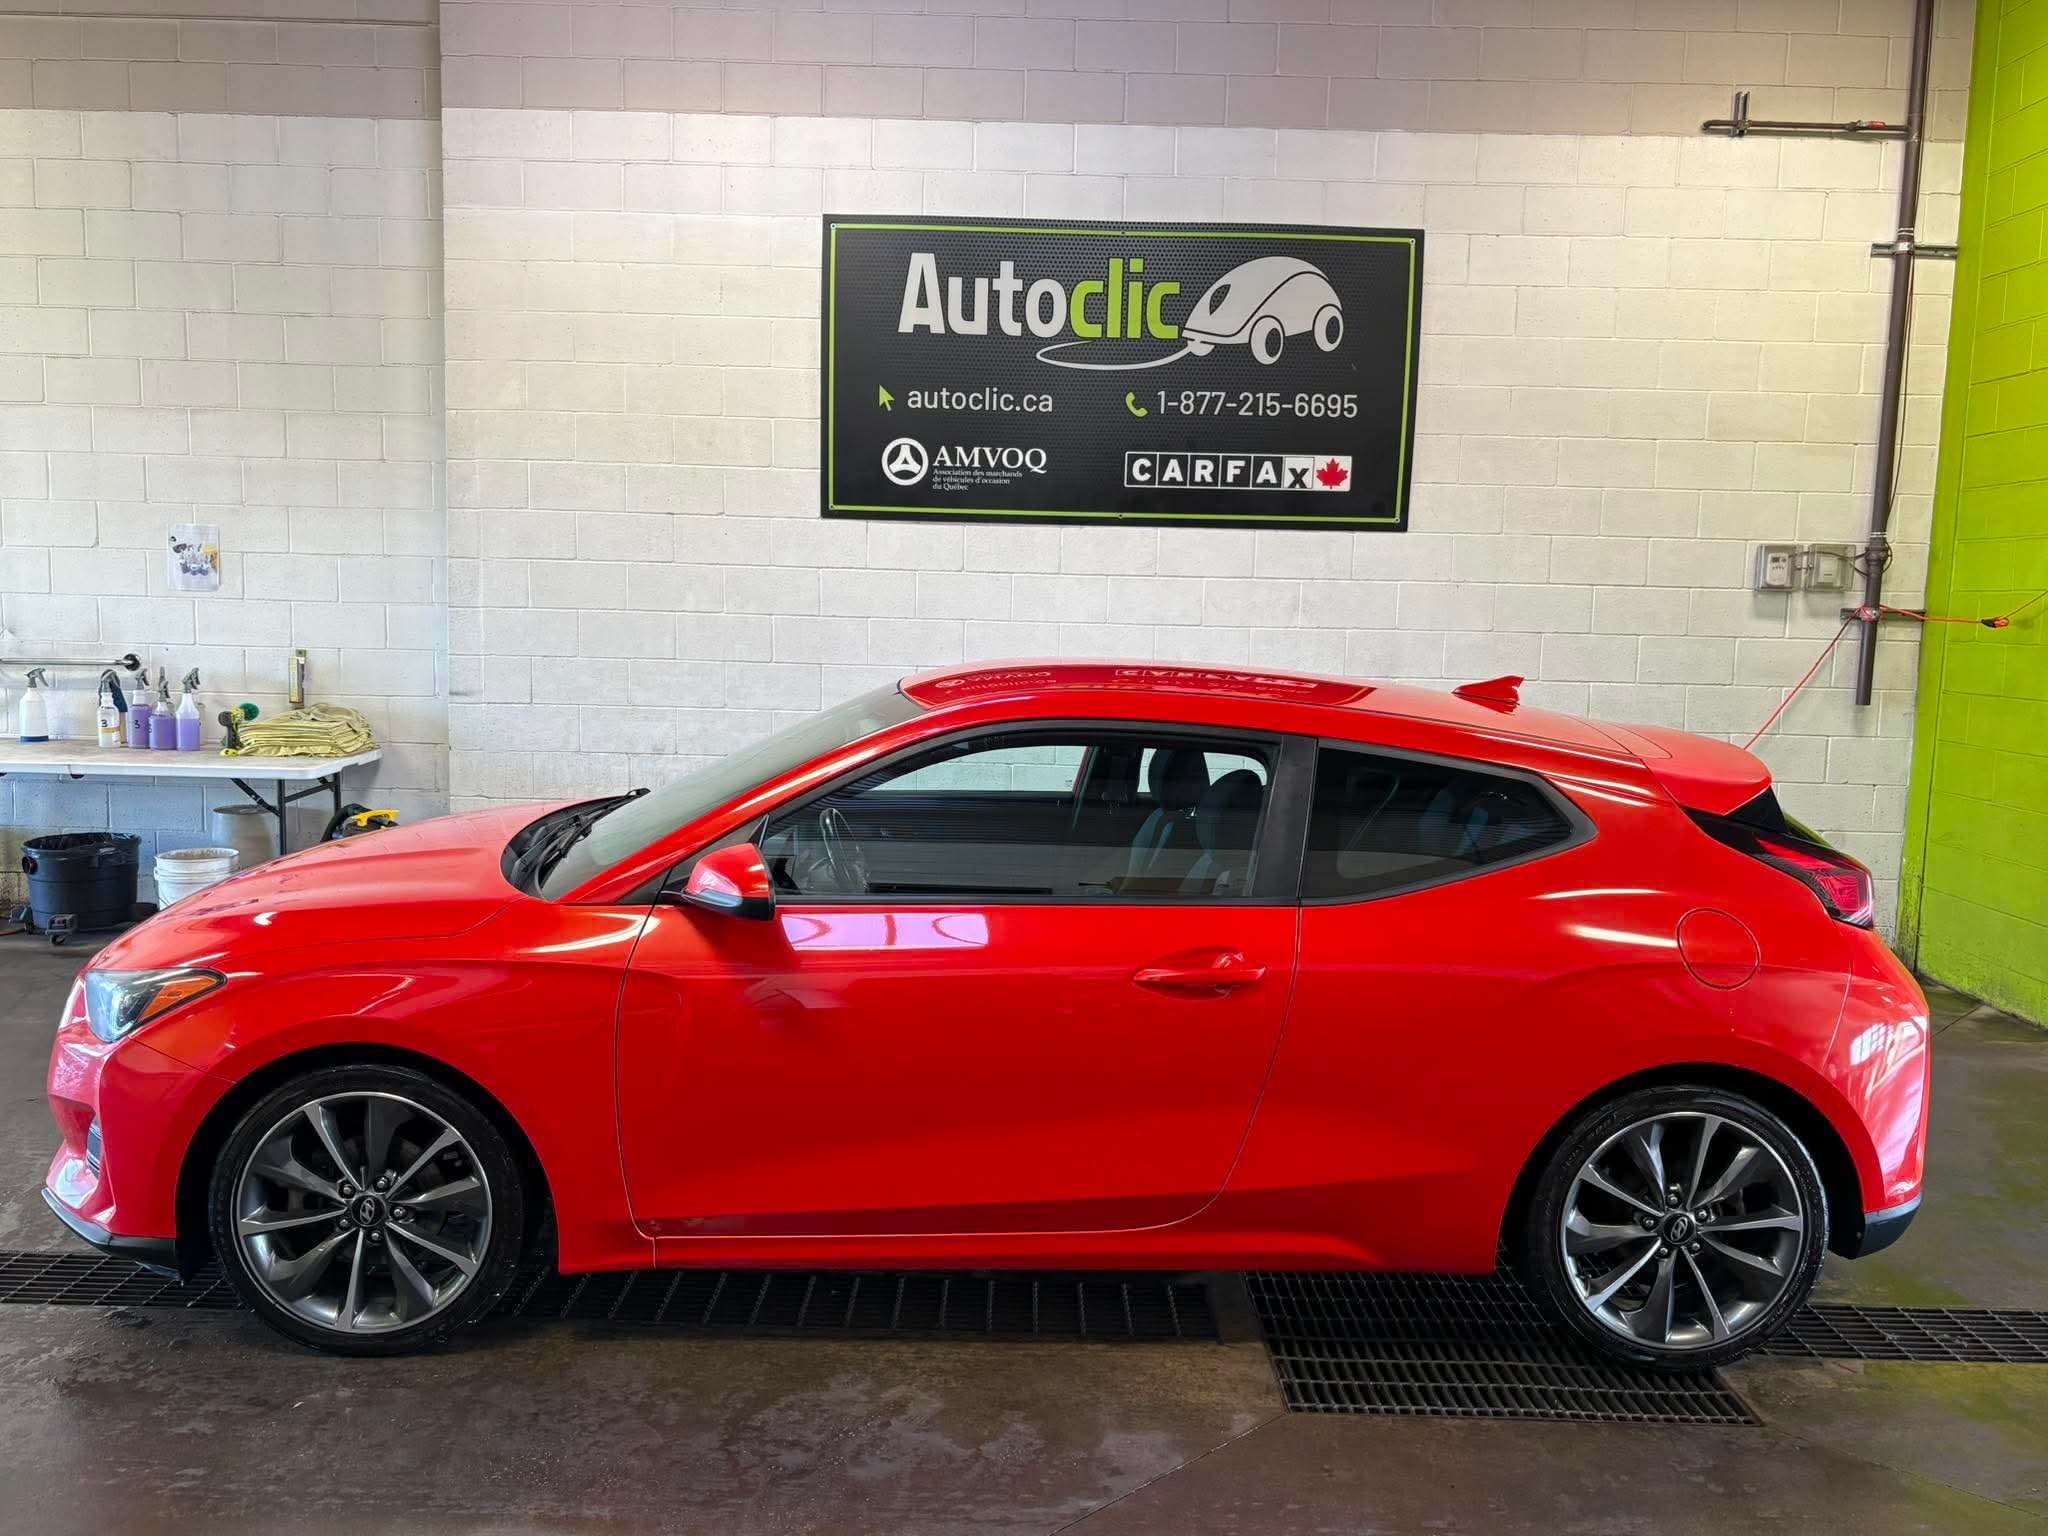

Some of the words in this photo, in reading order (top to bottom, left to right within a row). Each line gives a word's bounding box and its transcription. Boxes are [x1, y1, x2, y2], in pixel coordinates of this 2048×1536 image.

[898, 252, 1181, 340] Autoclic
[907, 387, 1053, 412] autoclic.ca
[1157, 390, 1358, 418] 1-877-215-6695
[932, 445, 1047, 474] AMVOQ
[932, 468, 972, 476] Association
[1132, 458, 1309, 488] CARFAX
